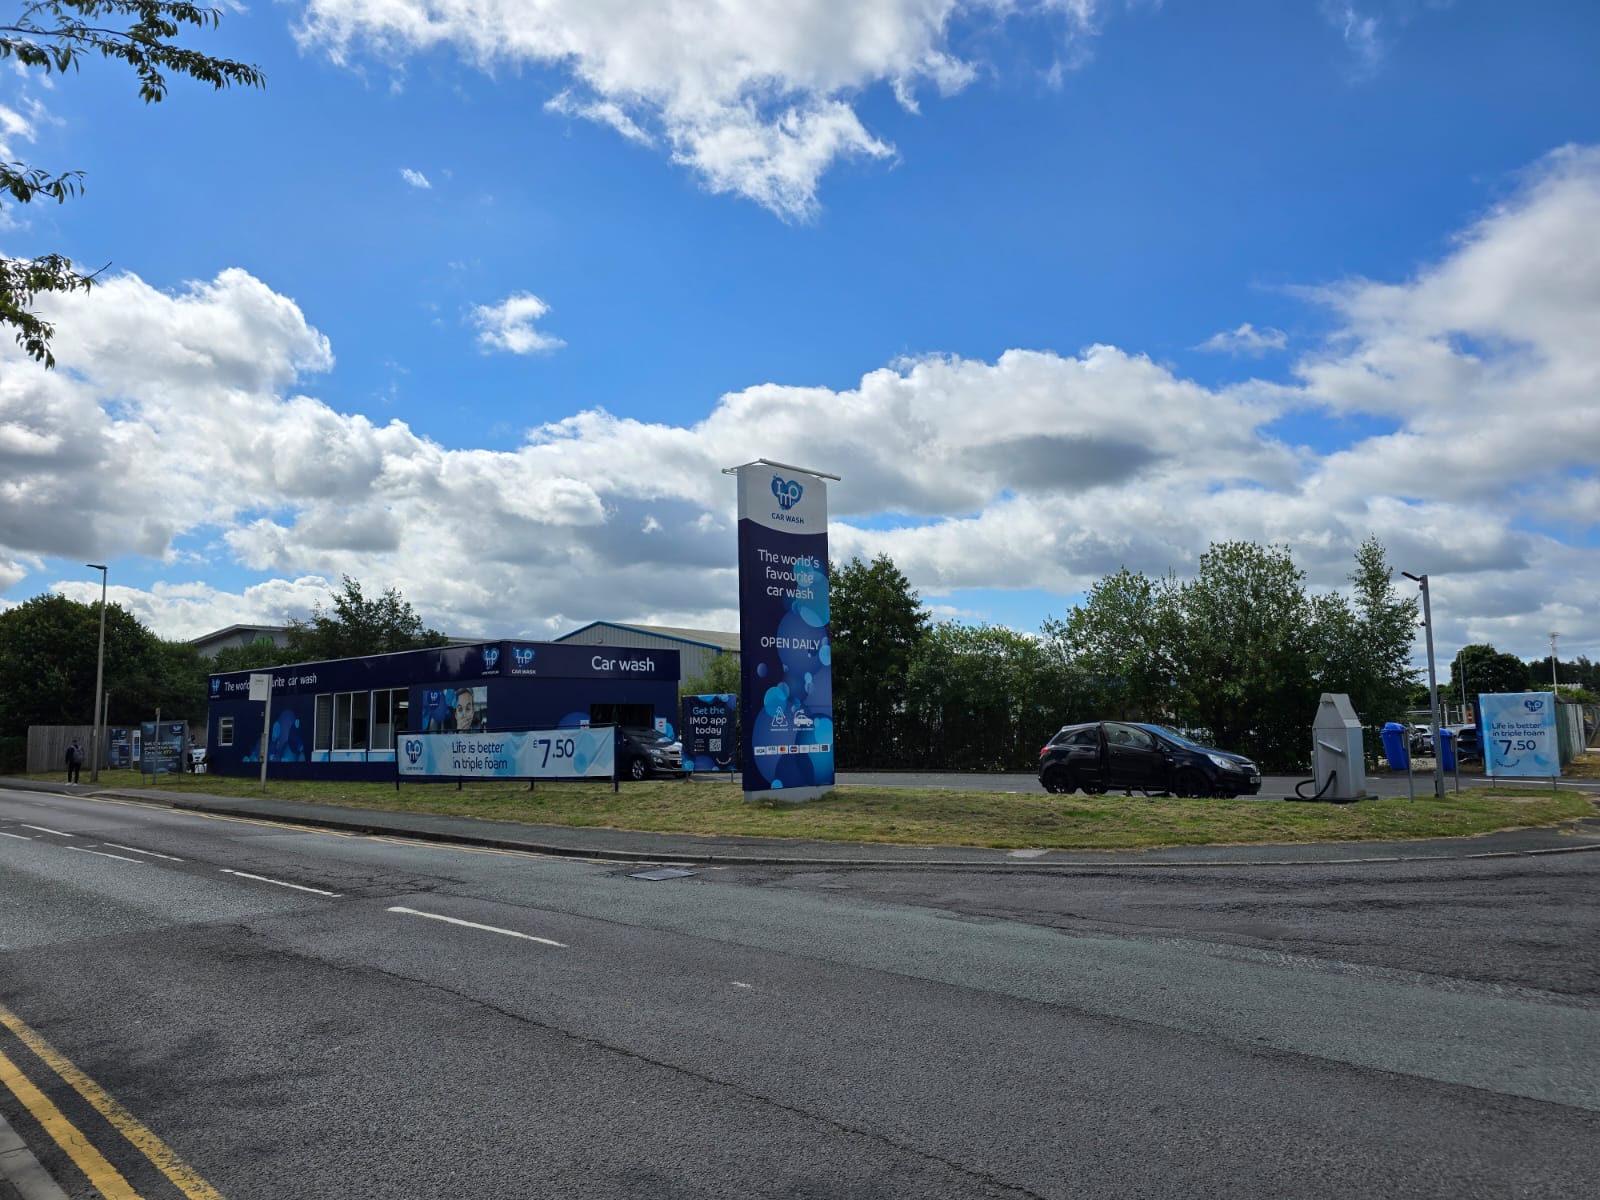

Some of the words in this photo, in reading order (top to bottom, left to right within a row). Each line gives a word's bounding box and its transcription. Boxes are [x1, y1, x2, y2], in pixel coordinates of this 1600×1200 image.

[771, 512, 785, 521] CAR
[785, 515, 805, 525] WASH
[757, 549, 779, 563] The
[781, 554, 820, 569] world's
[766, 566, 814, 584] favourite
[766, 586, 784, 597] car
[786, 587, 814, 600] wash
[760, 636, 790, 649] OPEN
[792, 638, 820, 650] DAILY
[591, 655, 616, 671] Car
[619, 656, 655, 672] wash
[224, 682, 235, 692] The
[288, 676, 298, 686] car
[300, 673, 316, 684] wash
[692, 706, 708, 715] Get
[709, 706, 725, 715] the
[690, 716, 708, 725] IMO
[710, 716, 727, 726] app
[695, 726, 722, 735] today
[1501, 730, 1522, 738] triple
[452, 741, 467, 754] Life
[468, 742, 475, 754] is
[477, 741, 504, 754] better
[453, 757, 460, 769] in
[461, 756, 482, 772] triple
[484, 756, 508, 769] foam
